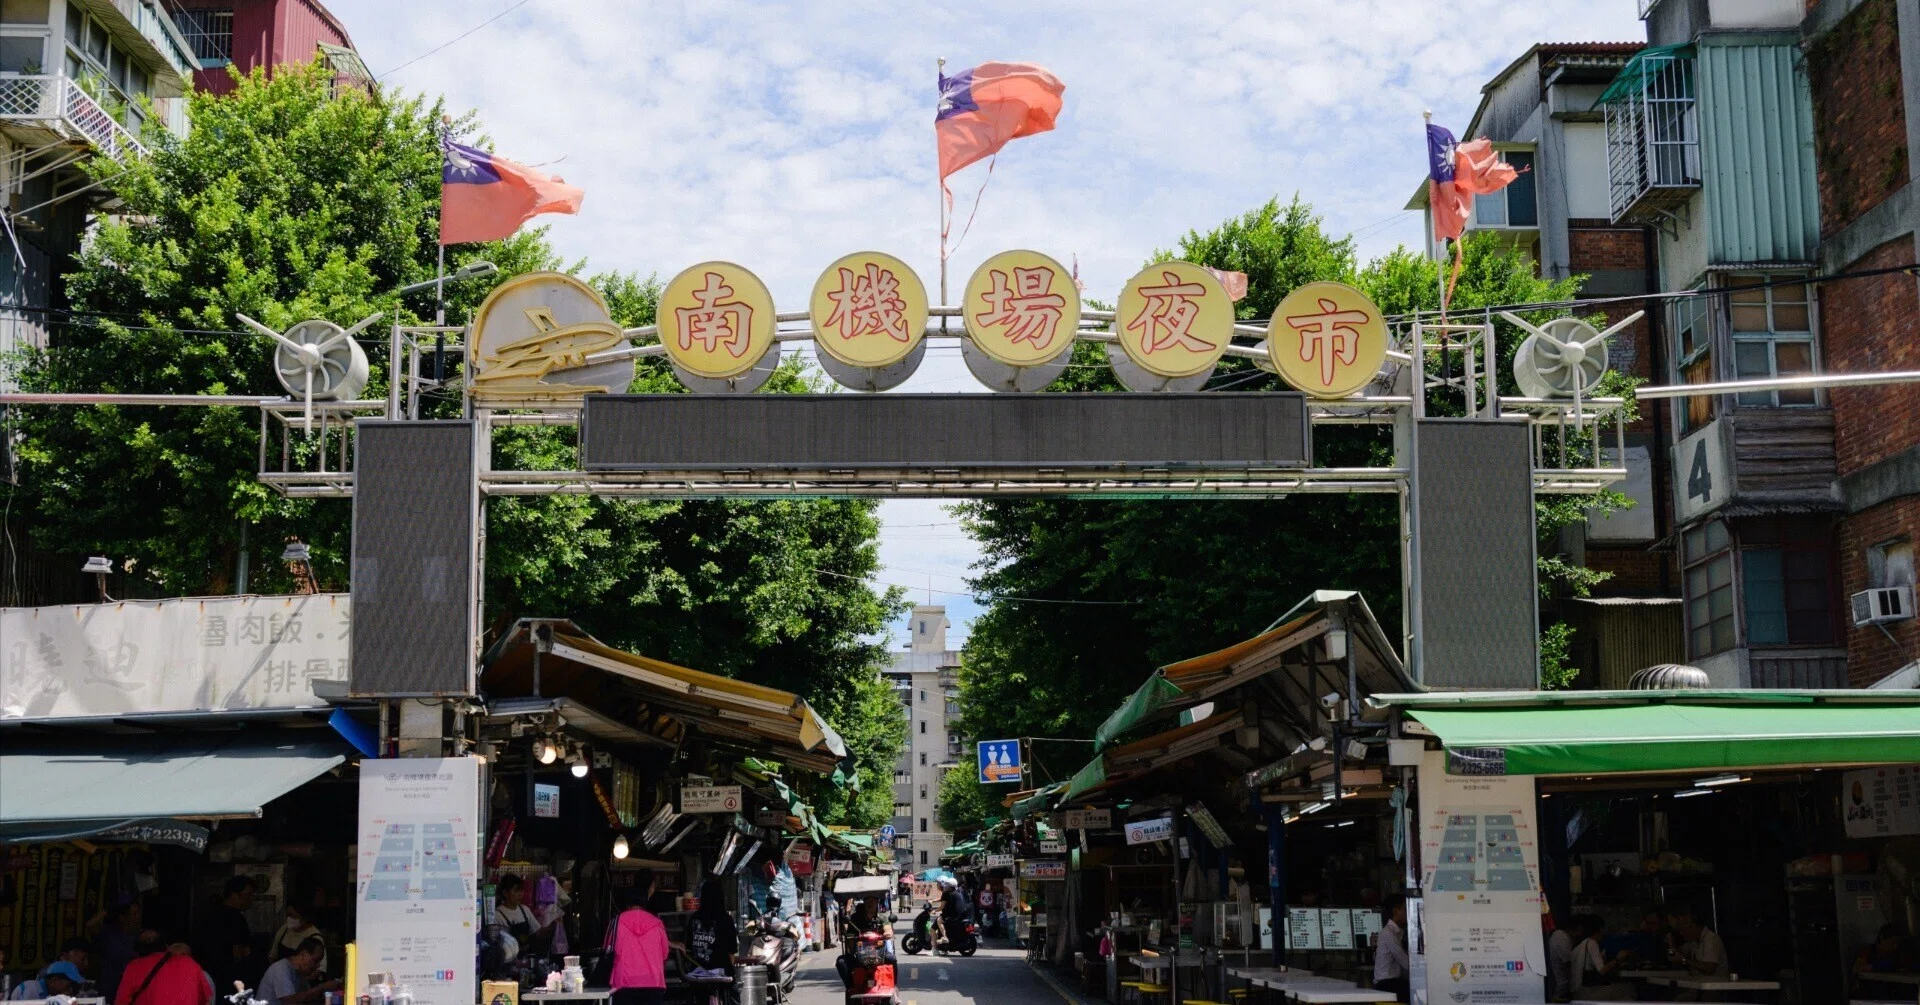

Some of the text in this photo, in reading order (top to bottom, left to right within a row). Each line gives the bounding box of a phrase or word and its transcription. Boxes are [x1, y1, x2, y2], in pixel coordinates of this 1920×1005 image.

[674, 262, 1370, 387] 南機場夜市
[1688, 437, 1712, 503] 4
